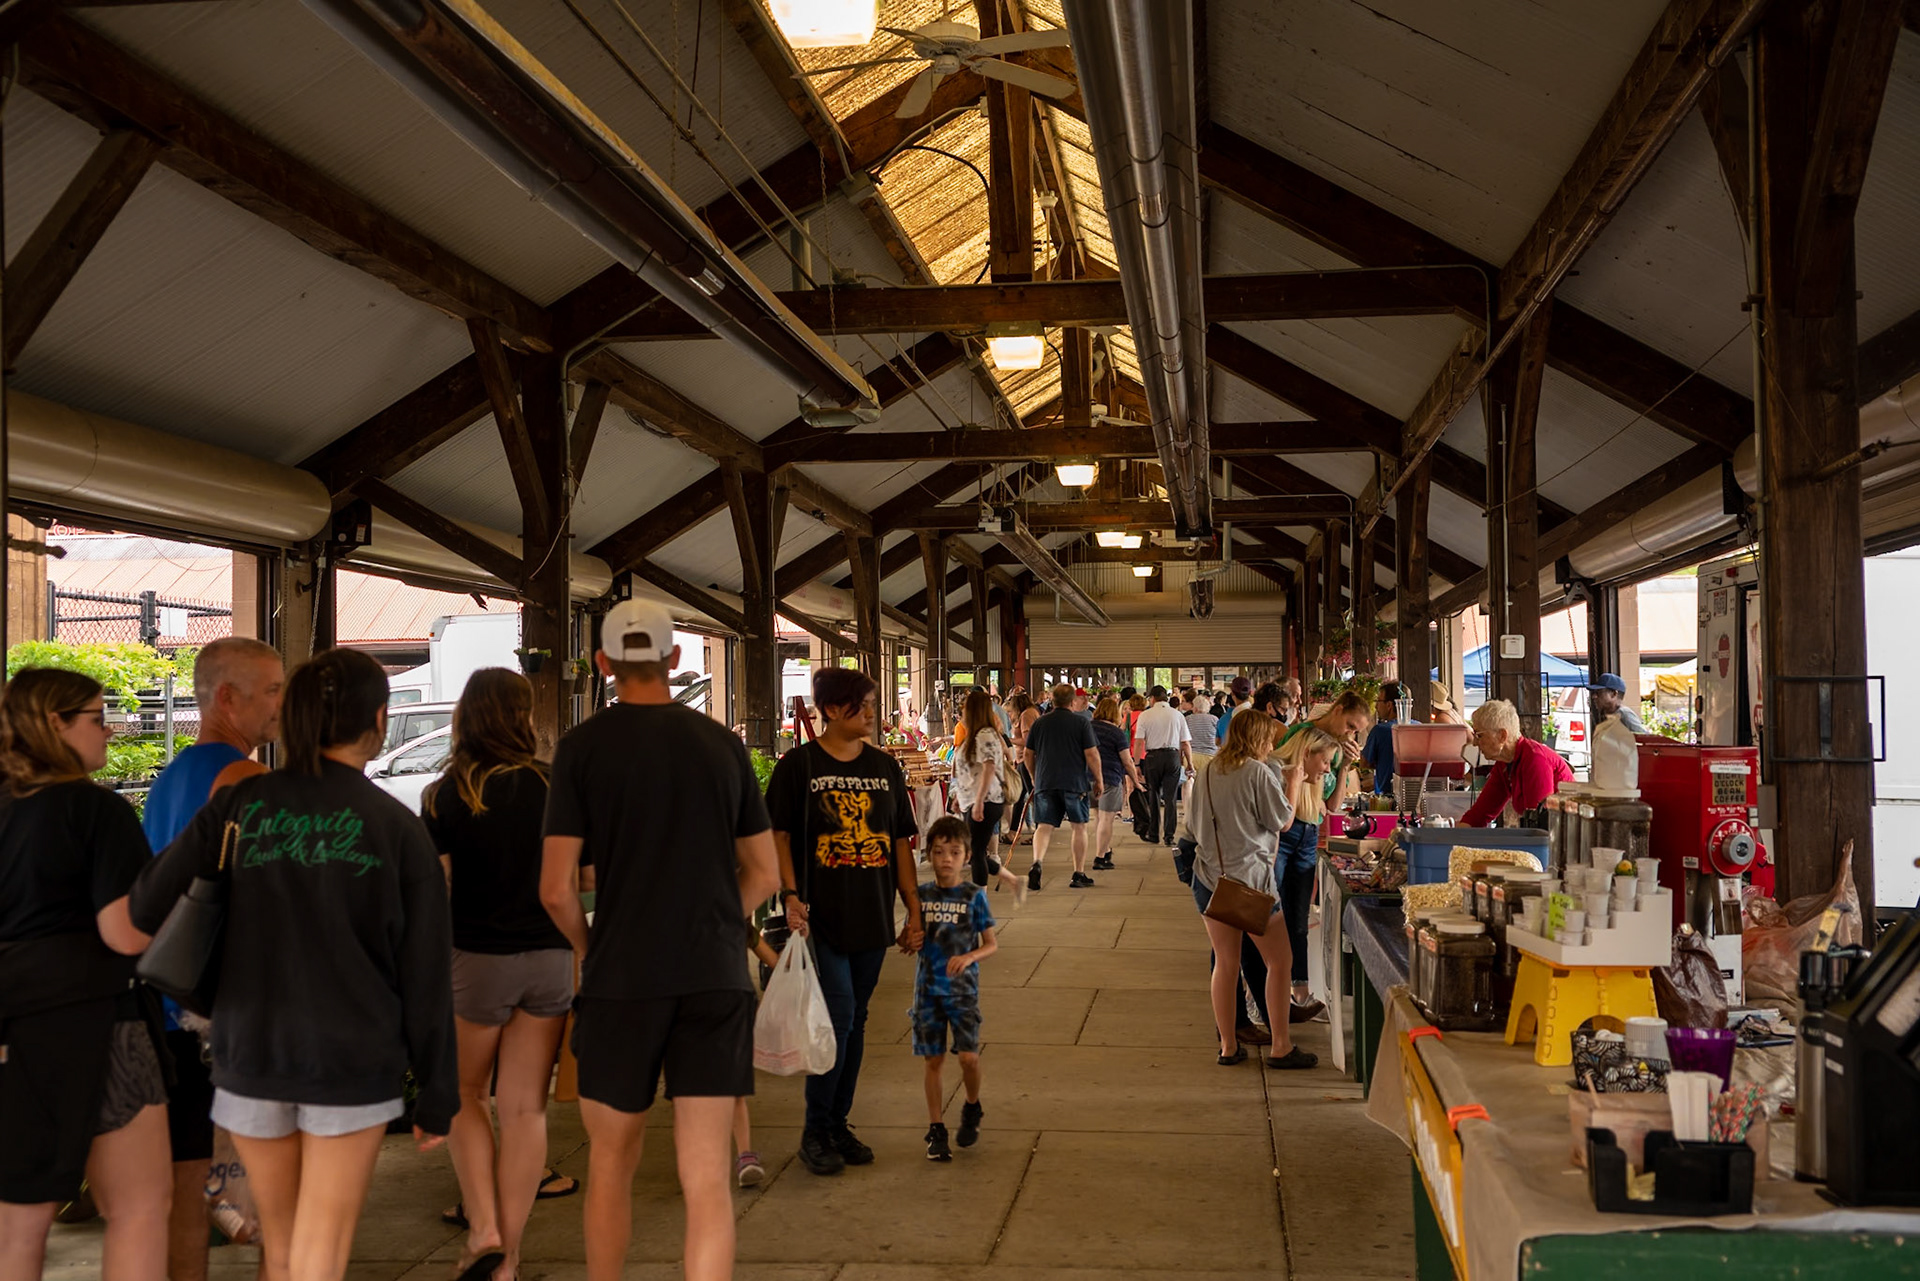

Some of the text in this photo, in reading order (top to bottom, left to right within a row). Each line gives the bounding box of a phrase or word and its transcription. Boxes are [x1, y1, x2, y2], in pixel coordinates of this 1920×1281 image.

[810, 775, 890, 793] OFFSPRING
[1714, 795, 1745, 803] COFFEE
[240, 799, 364, 851] Integrity
[921, 901, 967, 914] TROUBLE
[925, 912, 959, 924] MODE
